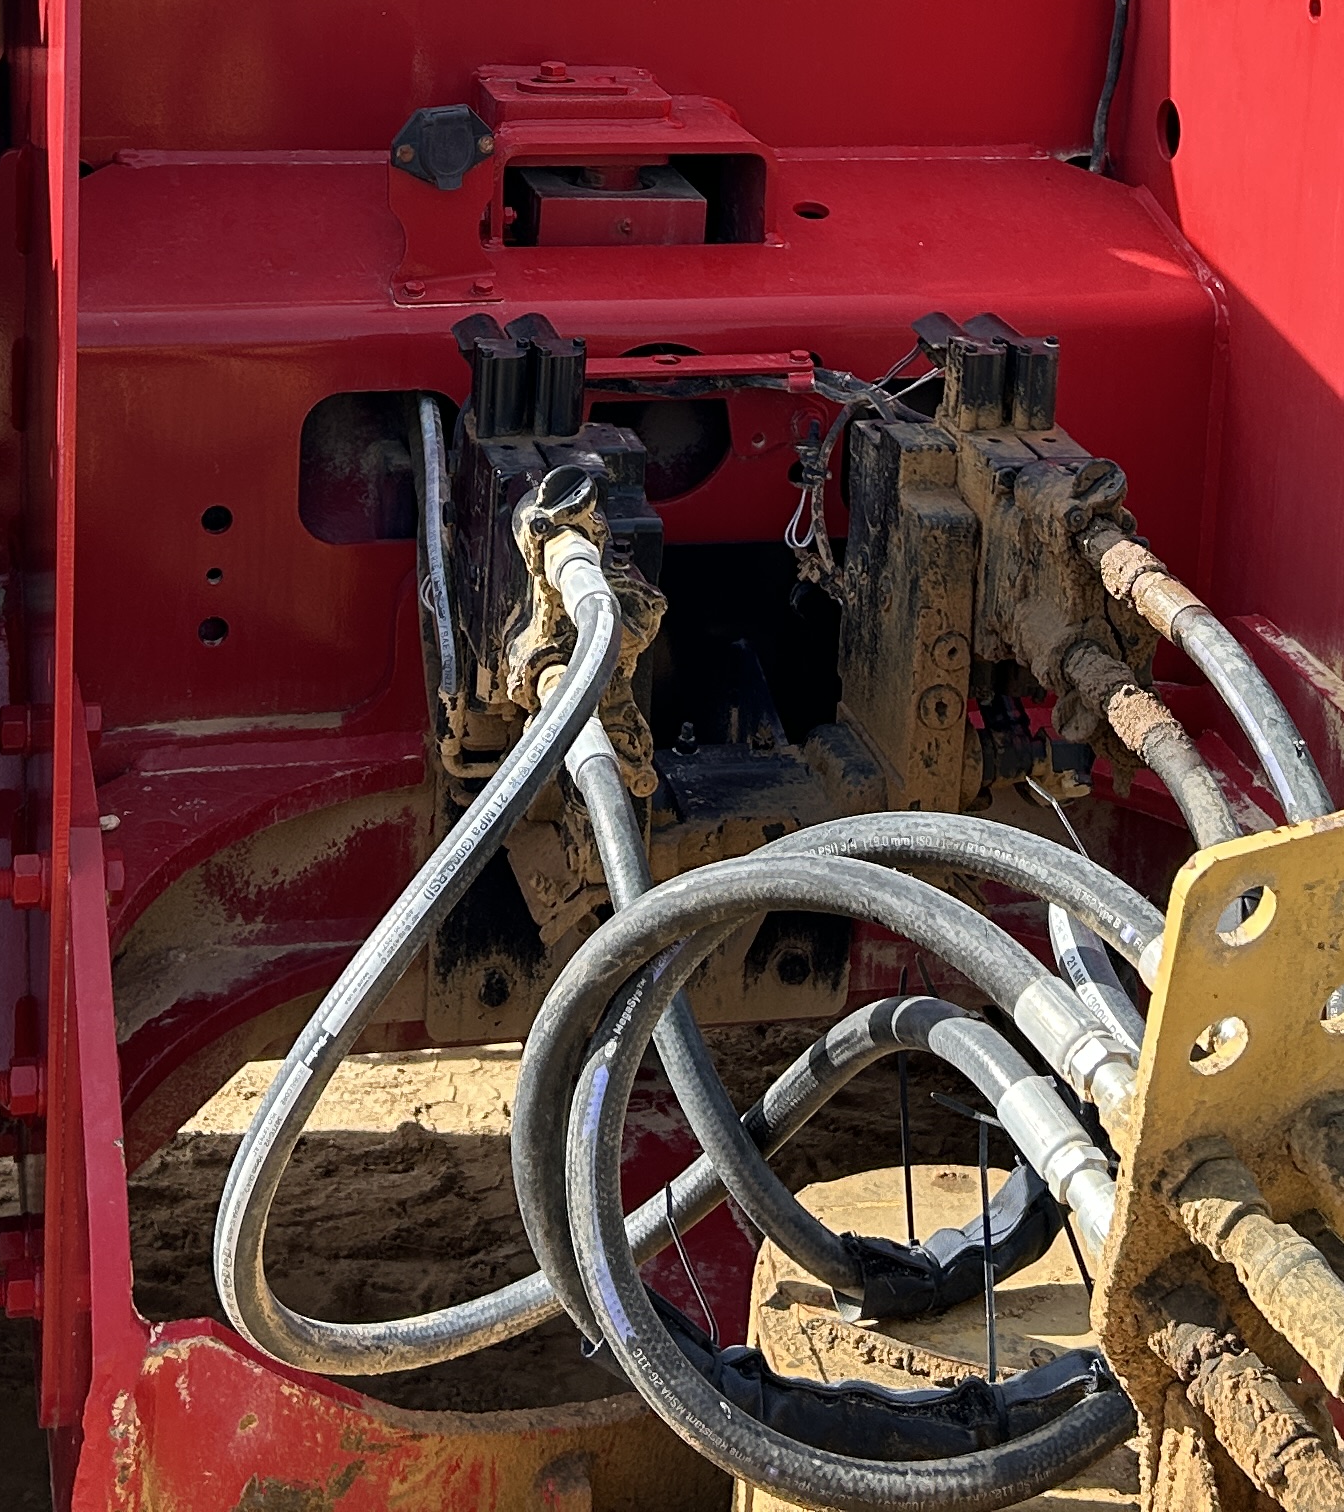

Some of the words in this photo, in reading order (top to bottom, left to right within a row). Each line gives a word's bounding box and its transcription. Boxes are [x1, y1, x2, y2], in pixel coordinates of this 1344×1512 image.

[497, 792, 510, 811] 21
[471, 808, 498, 837] MPa
[1097, 903, 1114, 925] Type
[1112, 916, 1122, 930] B
[1066, 955, 1079, 970] 21
[1072, 968, 1089, 995] MPa
[1086, 992, 1109, 1026] (3000
[659, 1386, 688, 1418] MSHA
[685, 1409, 729, 1454] Resistant
